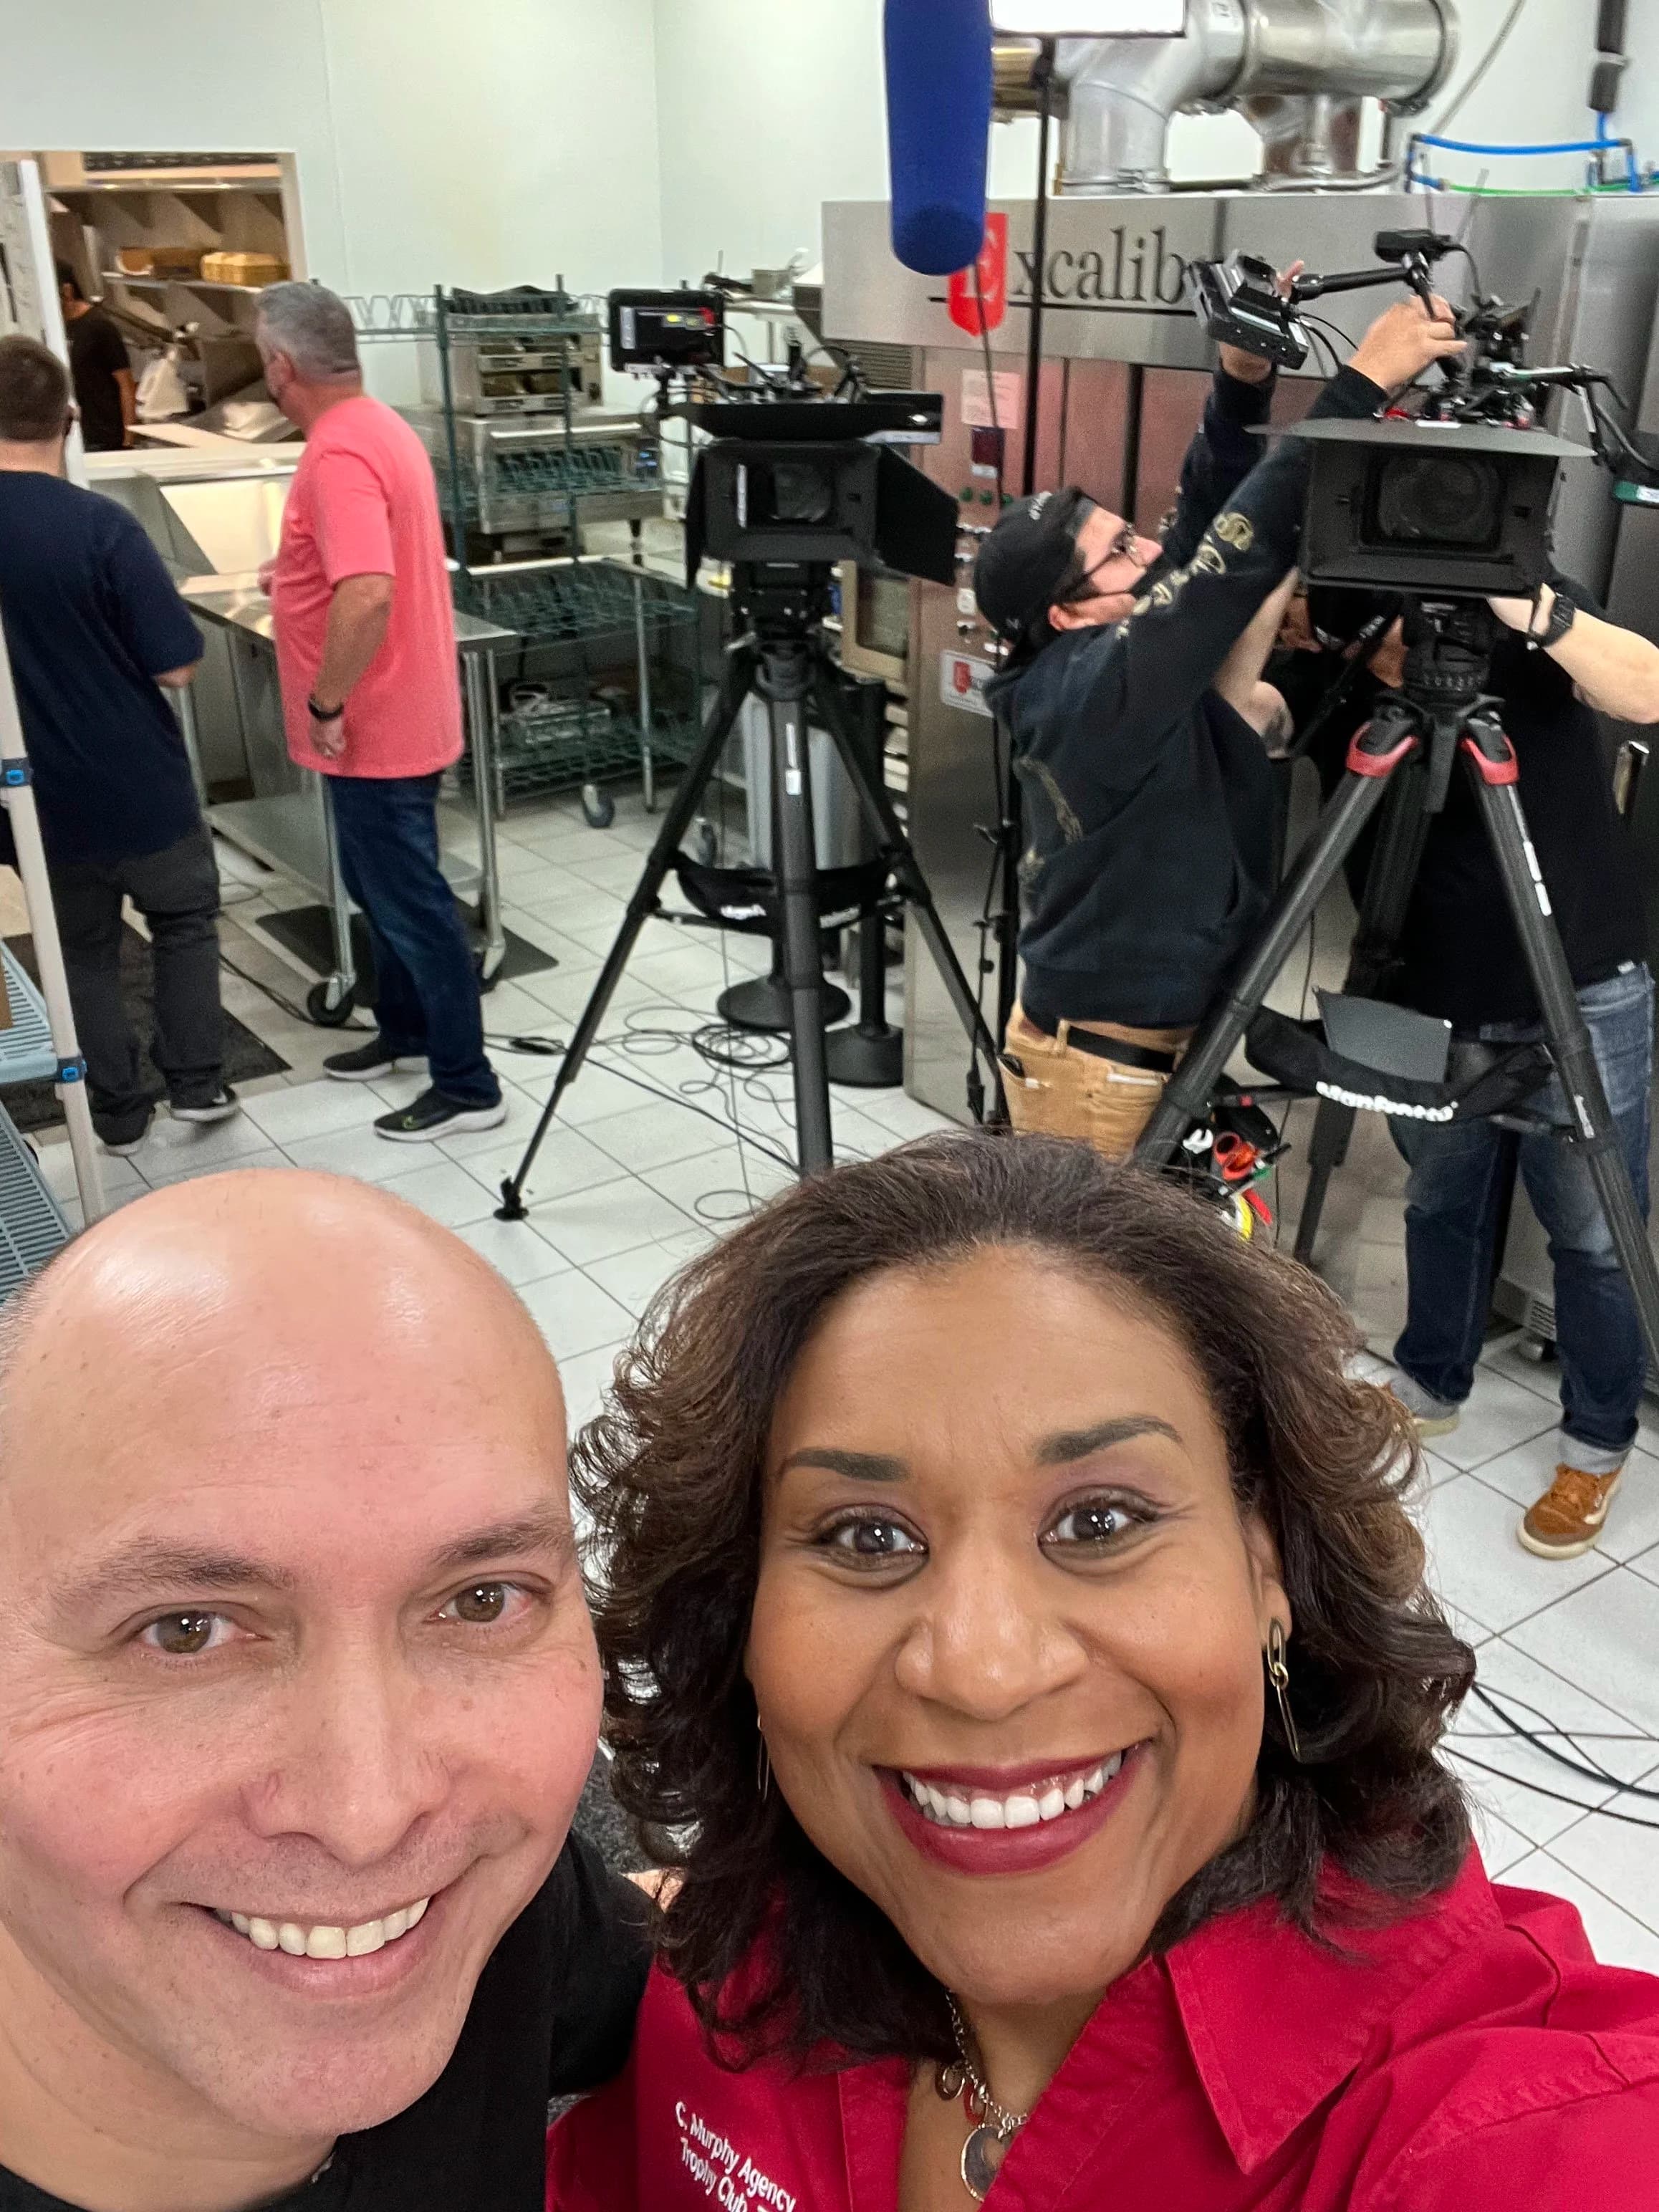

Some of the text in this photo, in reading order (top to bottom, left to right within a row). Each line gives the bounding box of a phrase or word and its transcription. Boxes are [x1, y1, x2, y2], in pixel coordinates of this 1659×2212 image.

[681, 2137, 717, 2196] Trophy
[690, 2112, 740, 2175] Murphy
[737, 2157, 796, 2212] Agency
